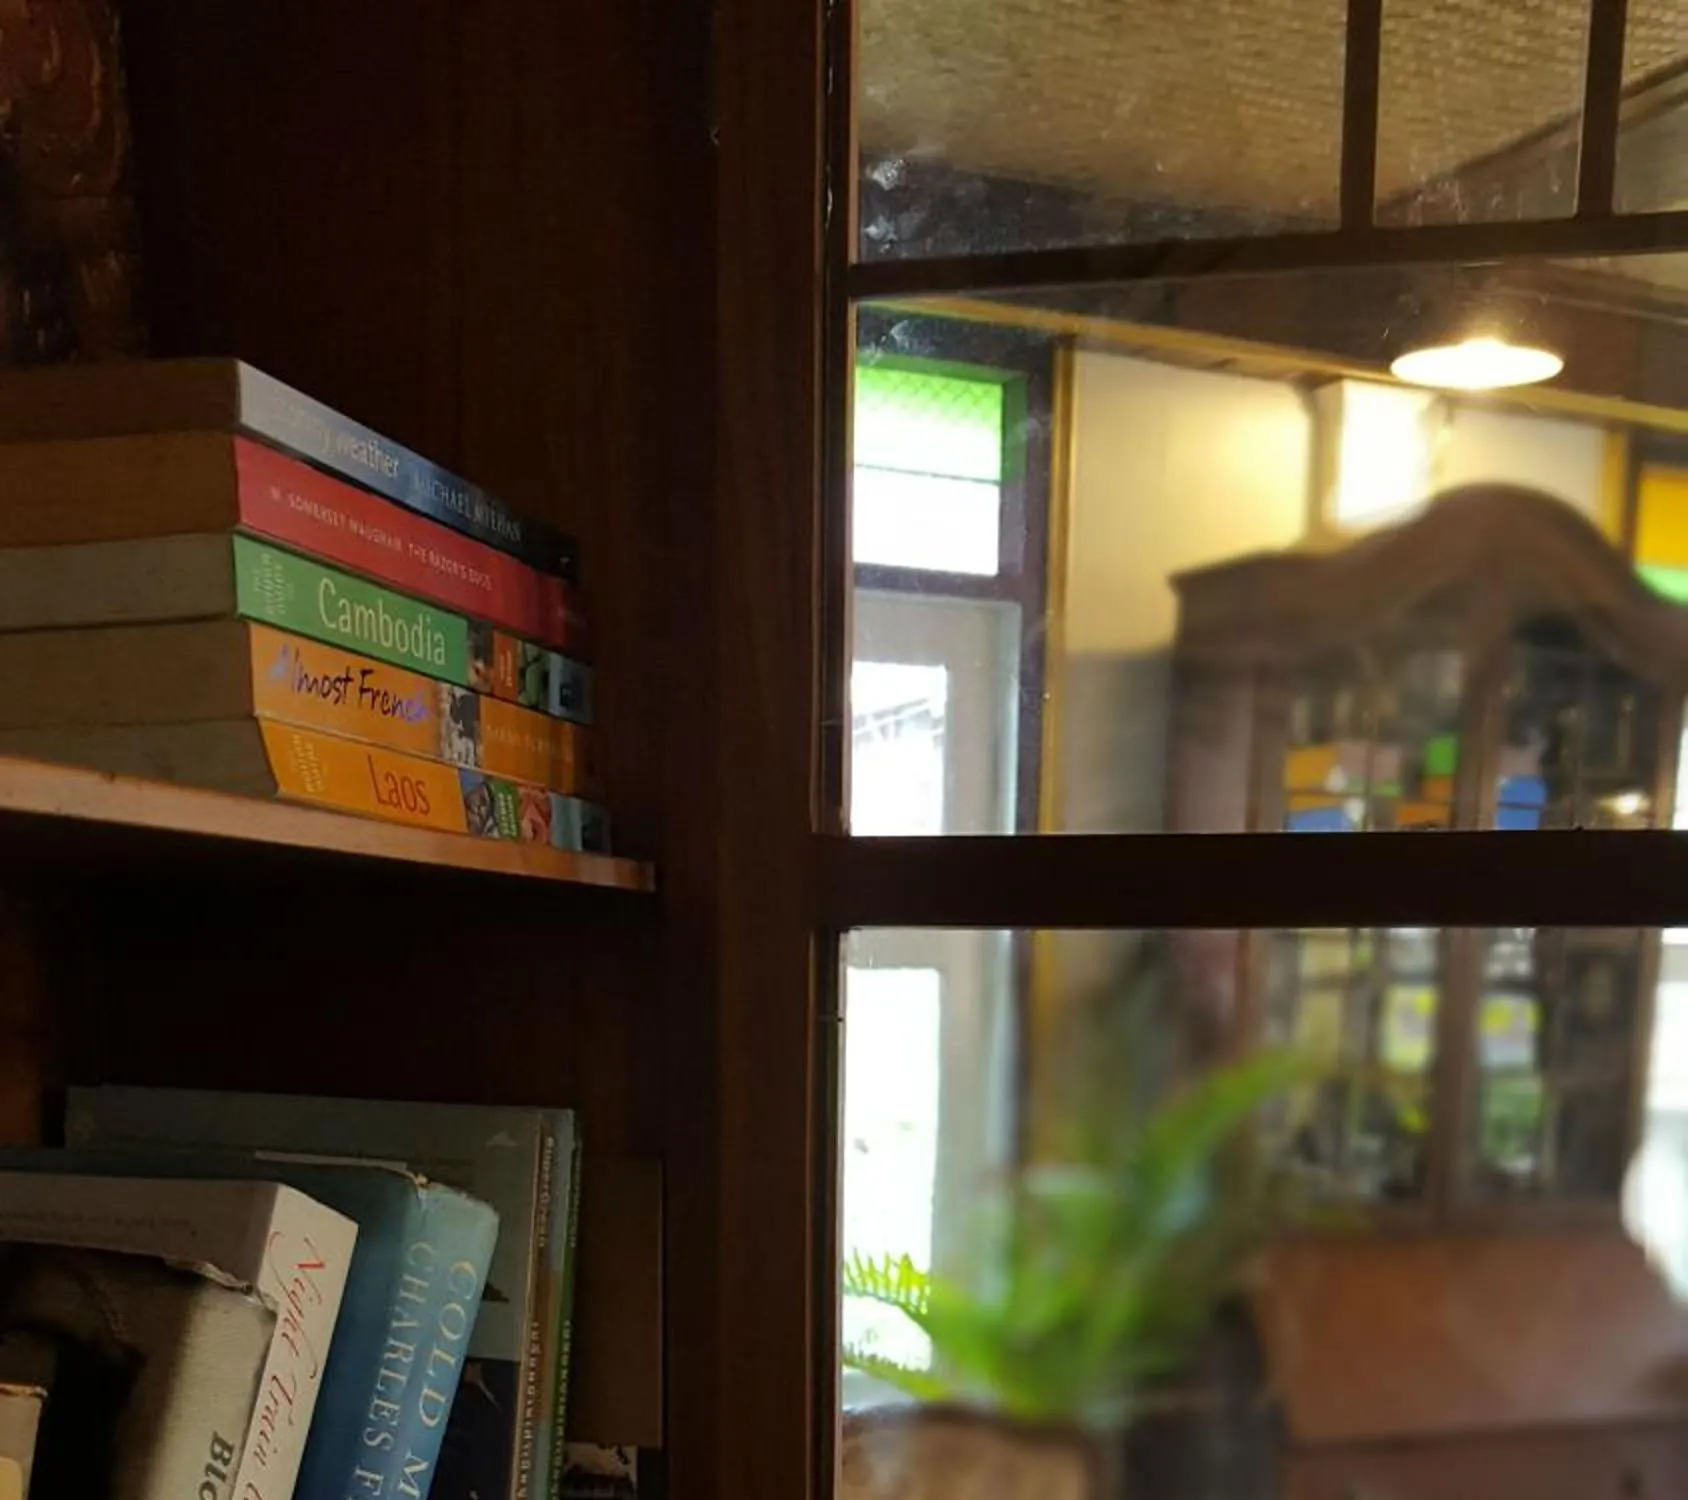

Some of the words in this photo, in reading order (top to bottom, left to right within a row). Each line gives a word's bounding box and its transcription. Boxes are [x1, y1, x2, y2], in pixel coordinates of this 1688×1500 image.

[318, 576, 446, 666] Cambodia
[270, 644, 354, 705] Almost
[358, 668, 427, 722] French
[368, 753, 431, 816] Laos
[270, 1231, 326, 1379] Night
[361, 1241, 435, 1452] CHARLES
[418, 1260, 478, 1428] COLD
[254, 1373, 297, 1466] Train
